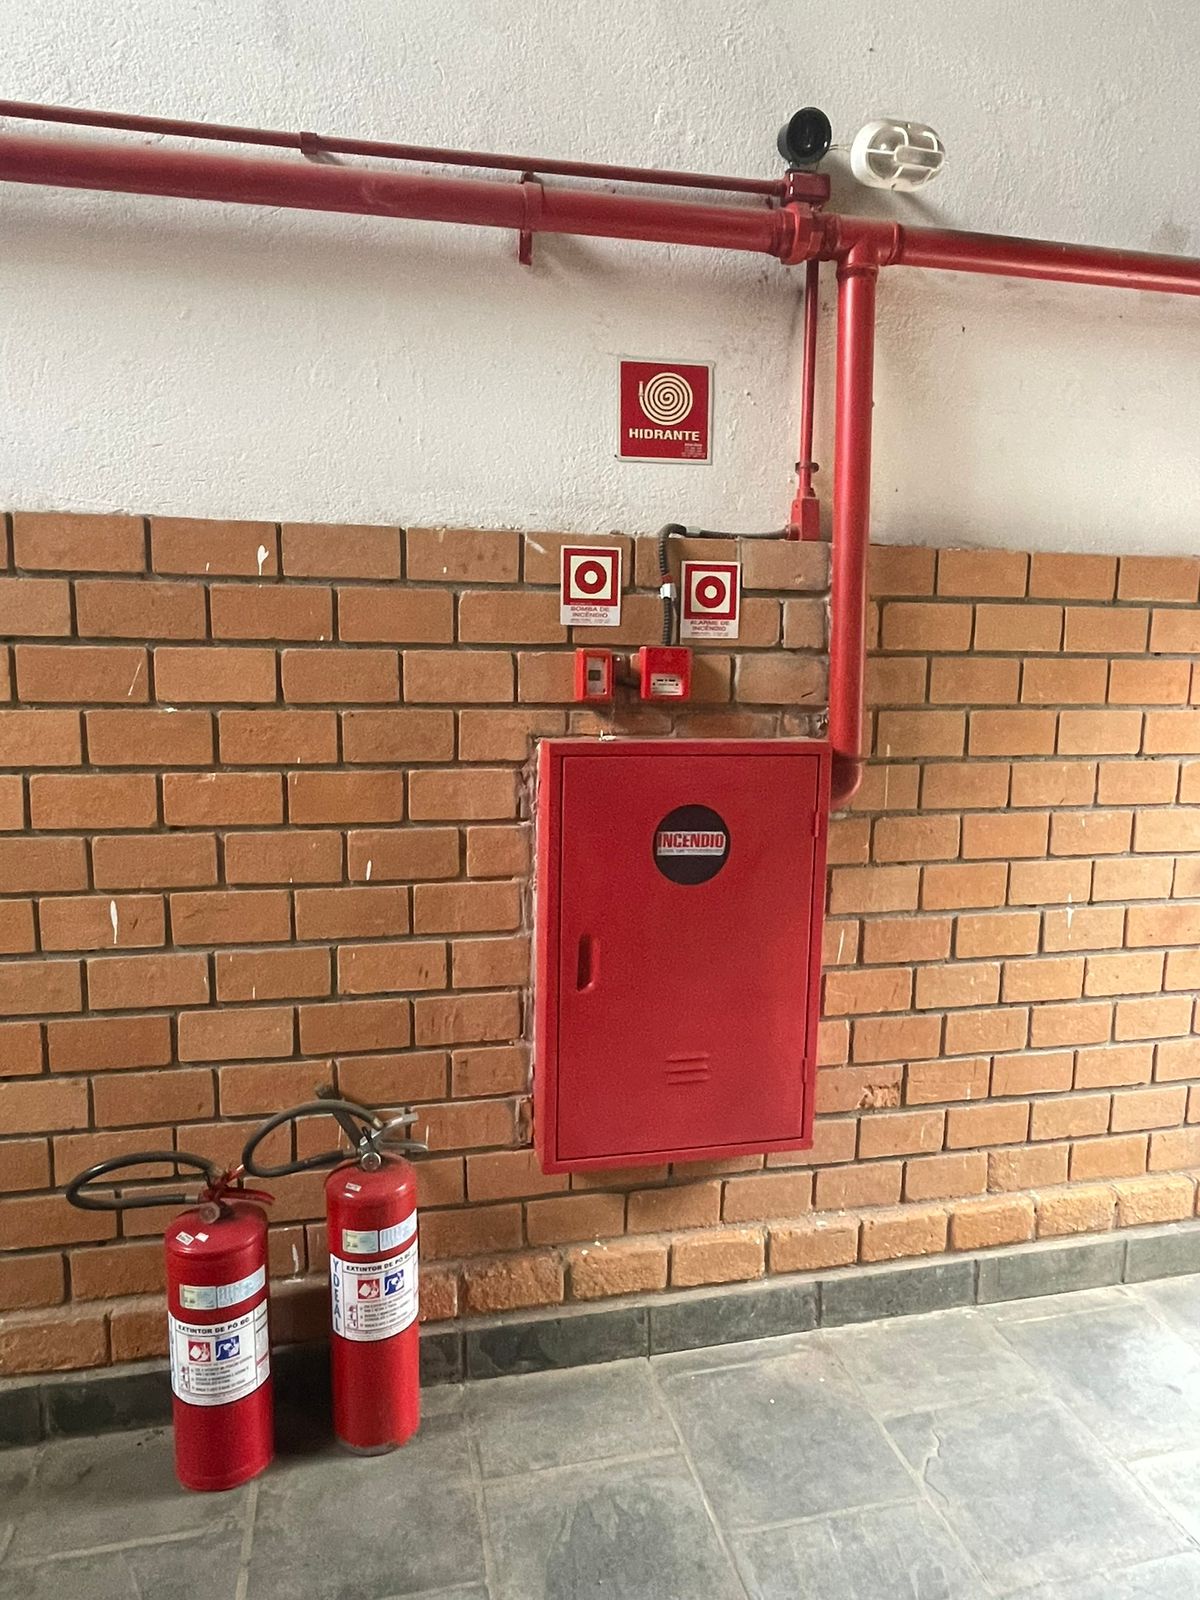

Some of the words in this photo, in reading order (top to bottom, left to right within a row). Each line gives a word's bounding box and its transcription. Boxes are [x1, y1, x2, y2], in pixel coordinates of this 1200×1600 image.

[628, 428, 700, 441] HIDRANTE
[178, 1324, 213, 1334] EXTINTOR
[214, 1326, 226, 1334] DE
